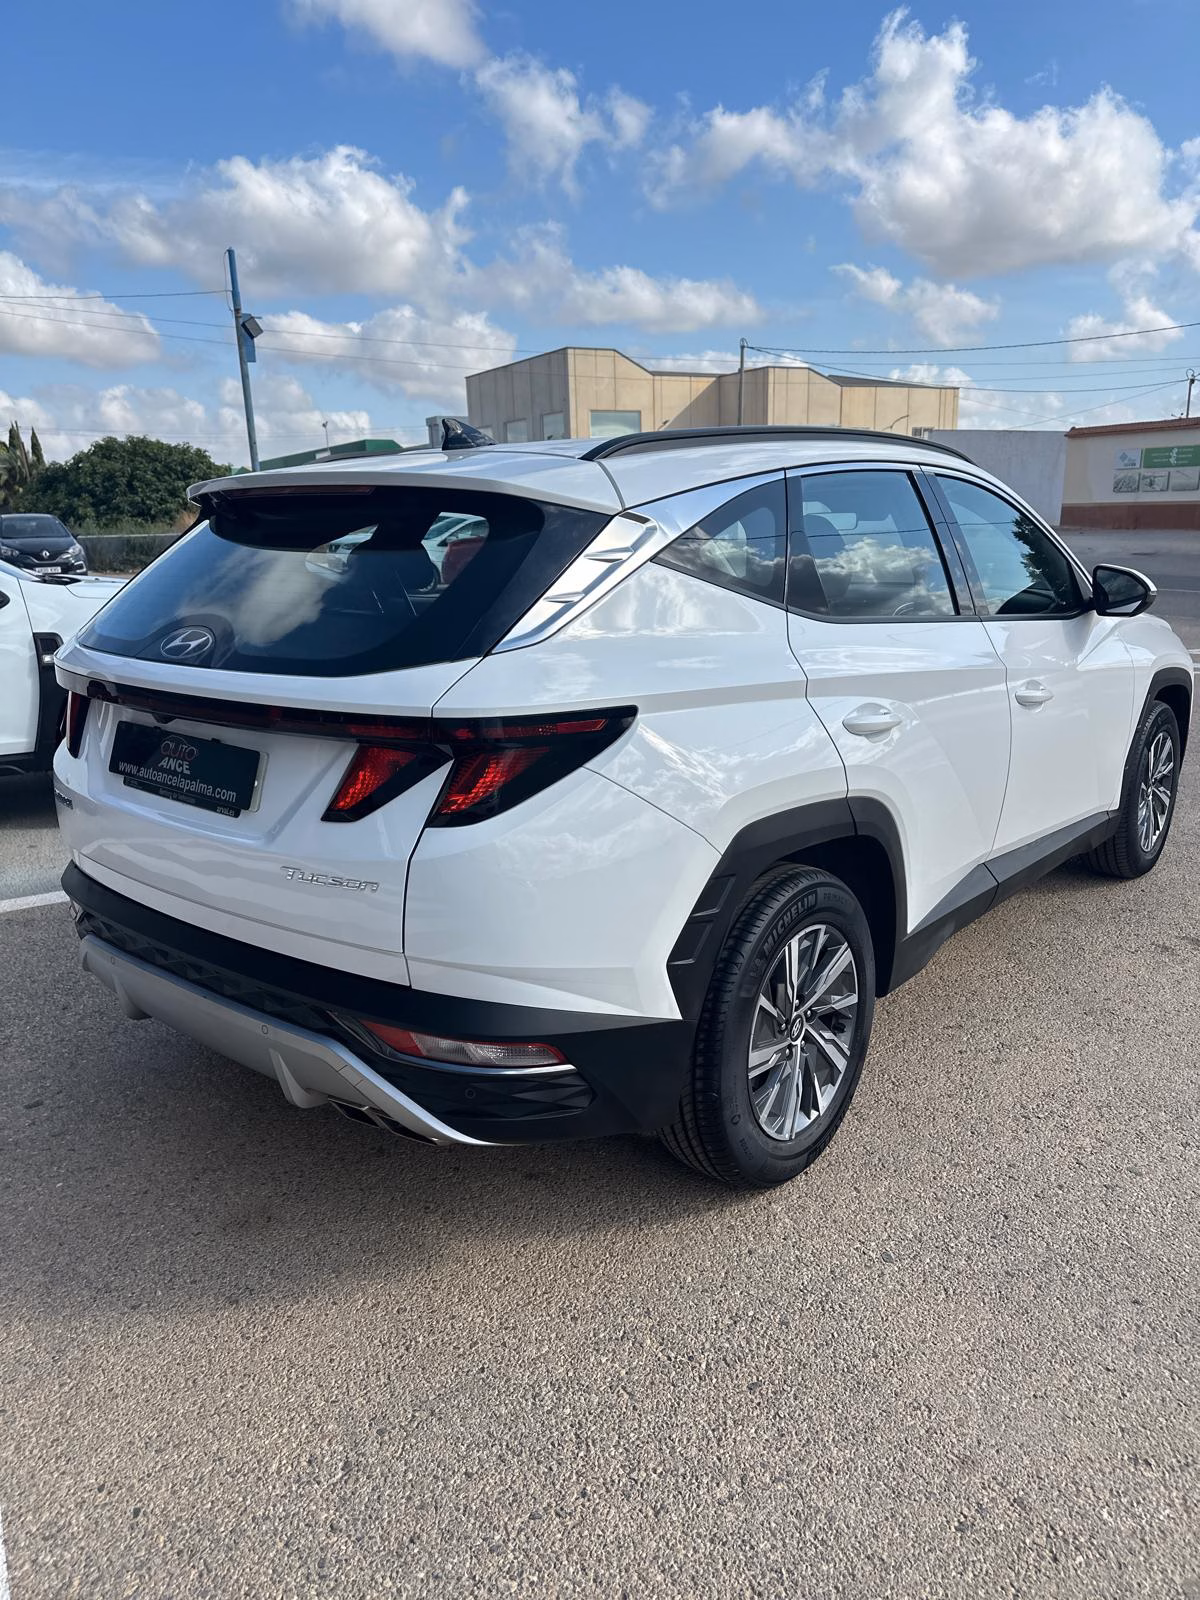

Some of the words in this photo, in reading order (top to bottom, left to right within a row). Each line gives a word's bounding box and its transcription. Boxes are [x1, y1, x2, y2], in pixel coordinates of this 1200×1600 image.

[118, 760, 237, 803] www.autoancelapalma.com
[158, 757, 191, 775] ANCE
[763, 893, 817, 955] MICHELIN
